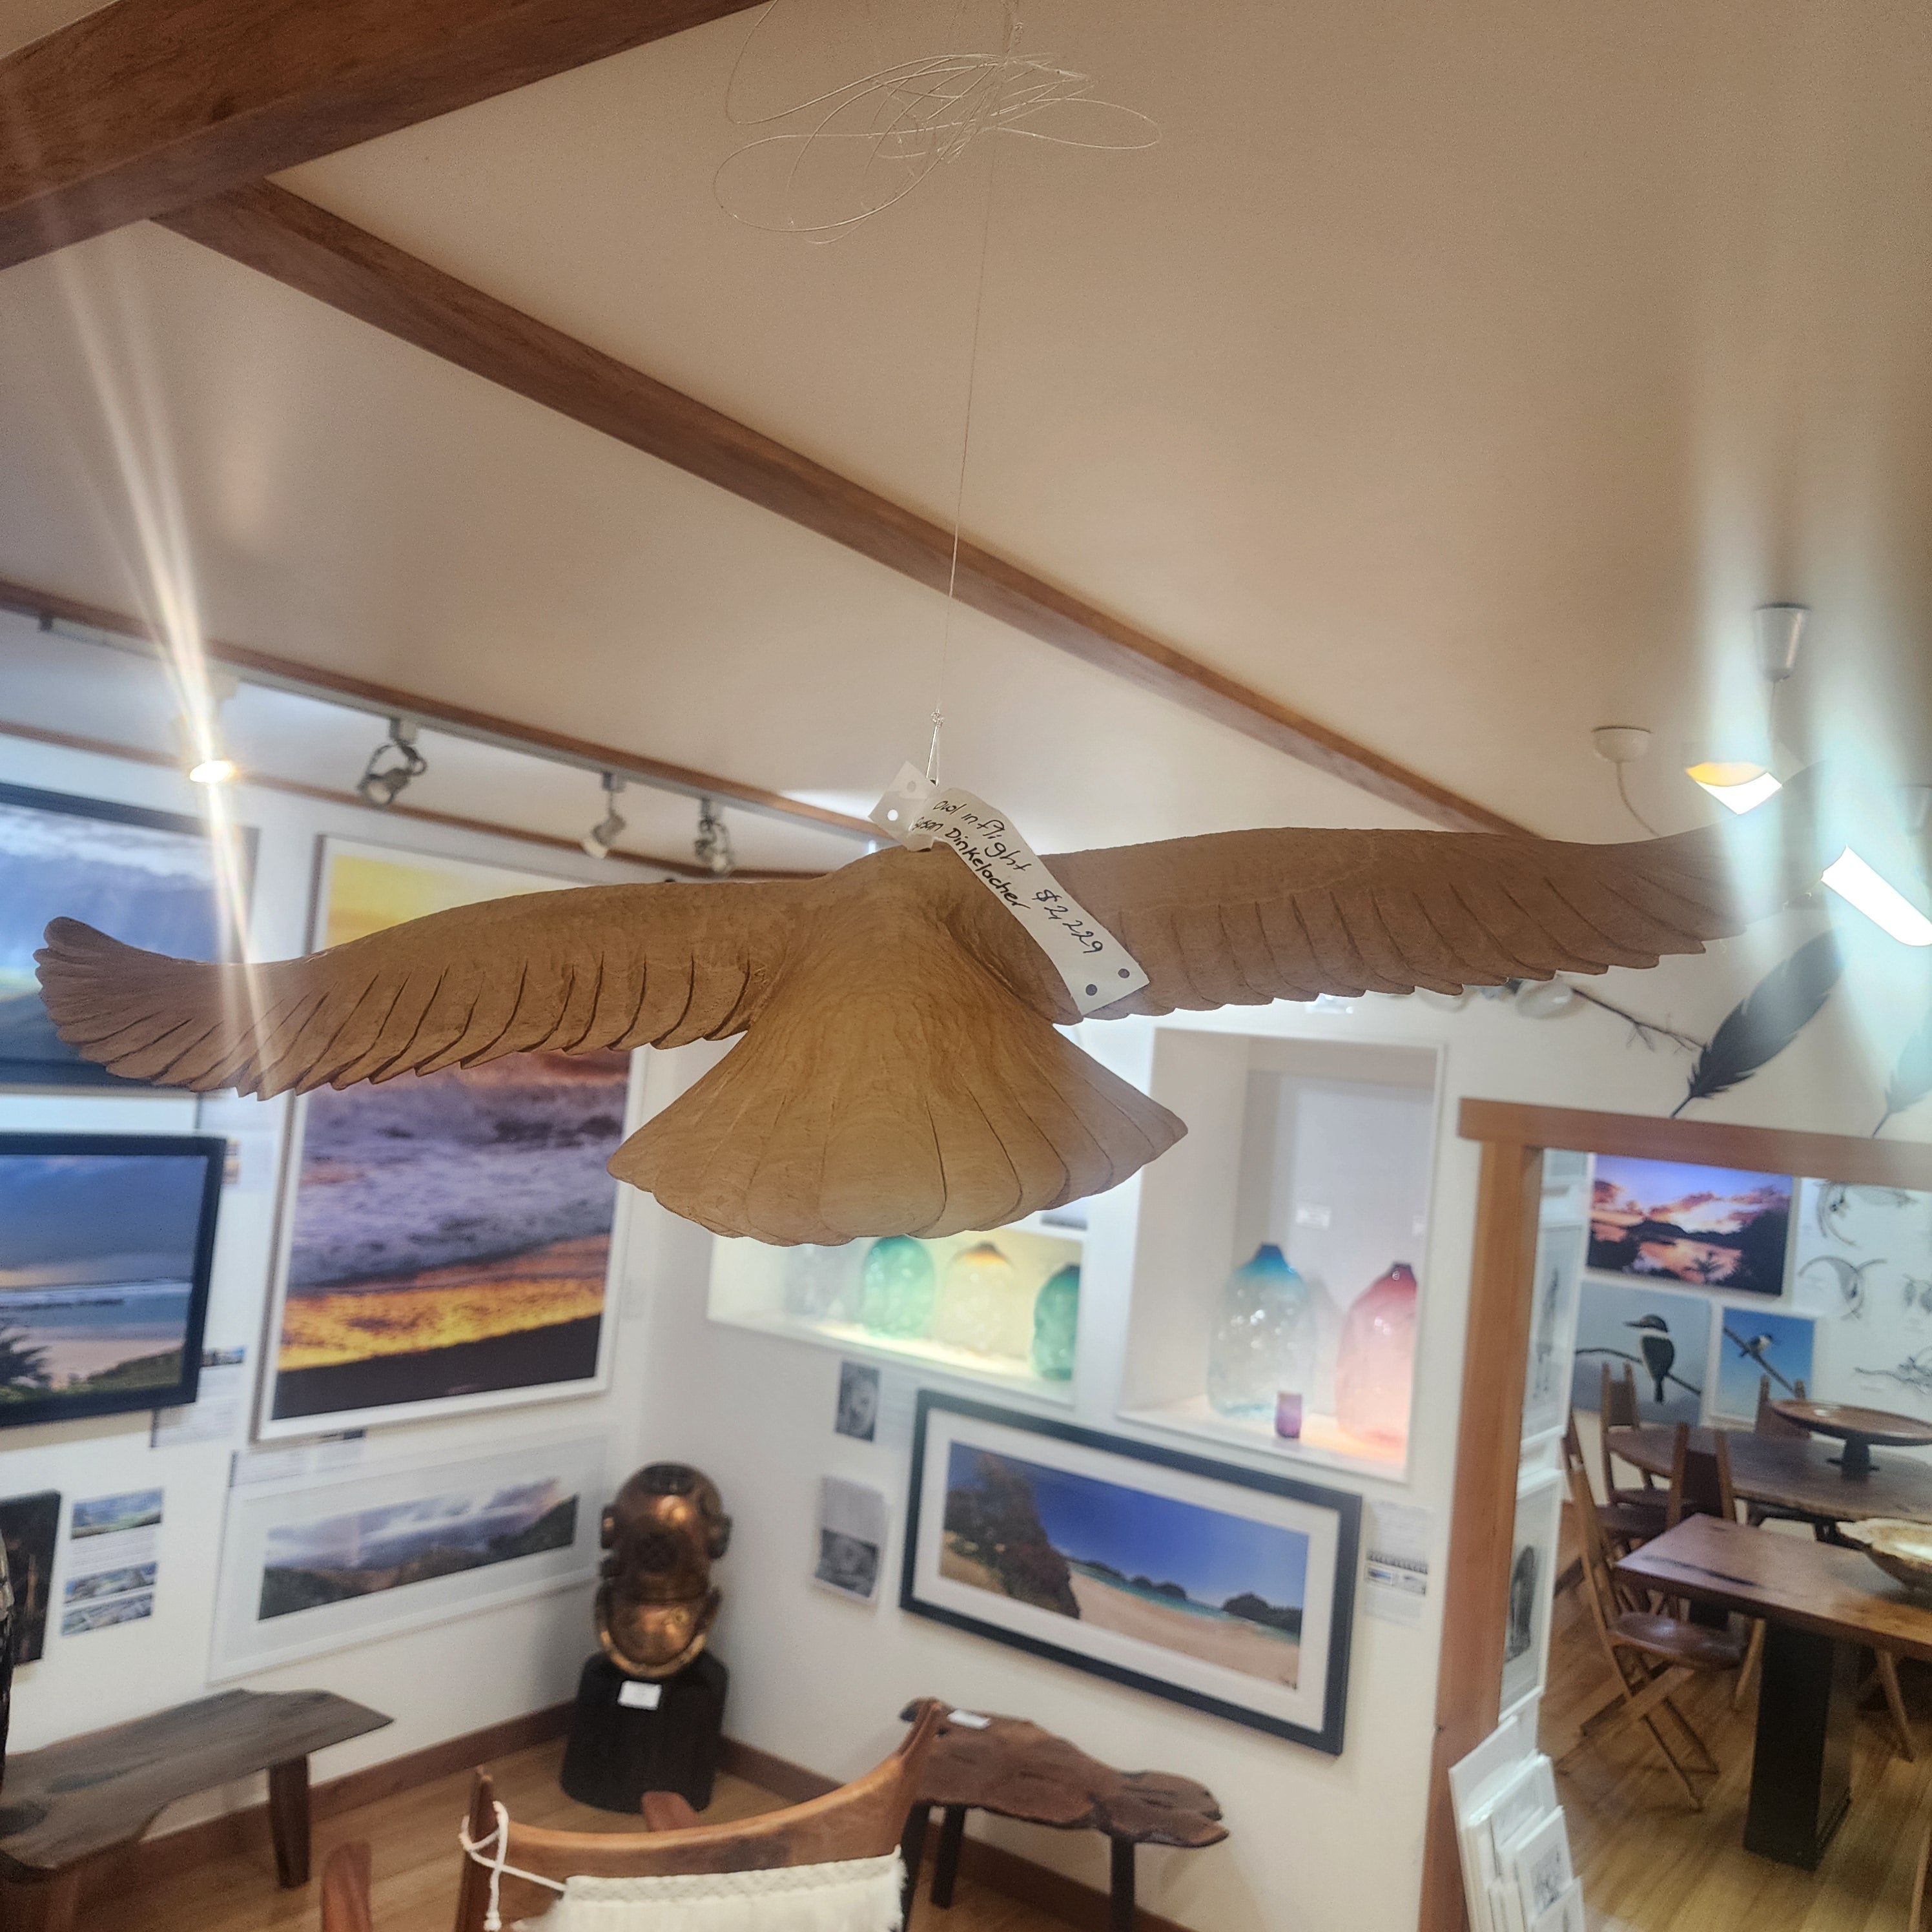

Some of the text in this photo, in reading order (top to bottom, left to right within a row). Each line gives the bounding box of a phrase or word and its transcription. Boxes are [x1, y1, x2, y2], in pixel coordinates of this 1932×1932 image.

[932, 801, 1103, 953] Owl in flight $2,229
